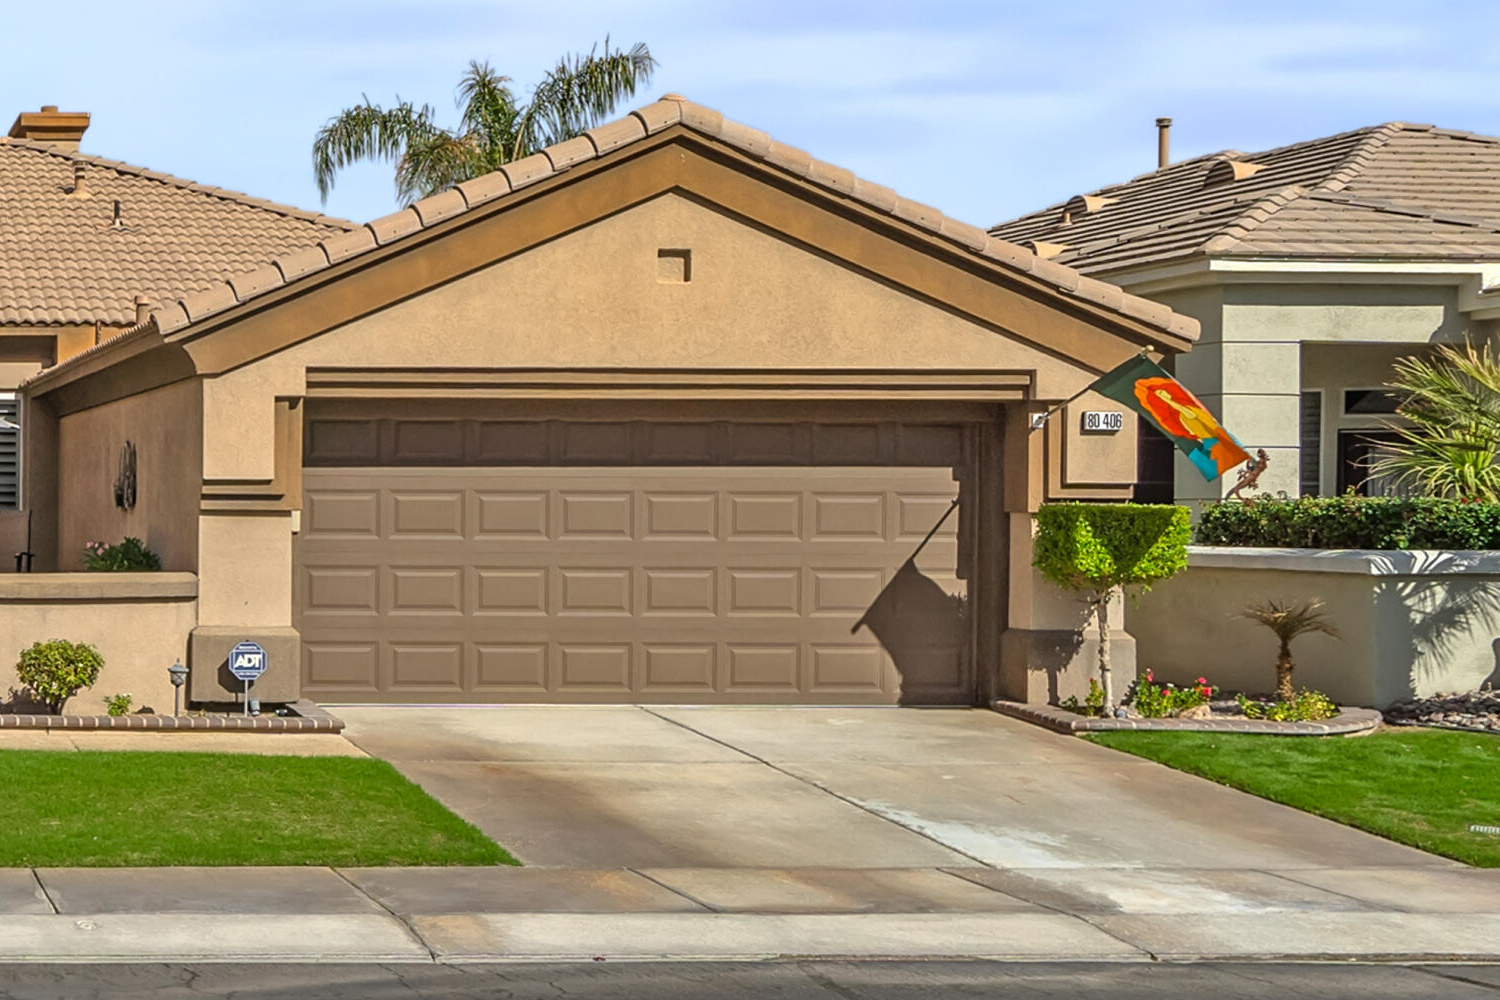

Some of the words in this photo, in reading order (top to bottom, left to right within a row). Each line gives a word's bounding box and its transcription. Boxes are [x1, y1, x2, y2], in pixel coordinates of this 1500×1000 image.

[1087, 413, 1100, 429] 80
[1102, 413, 1123, 429] 406
[234, 654, 262, 668] ADT
